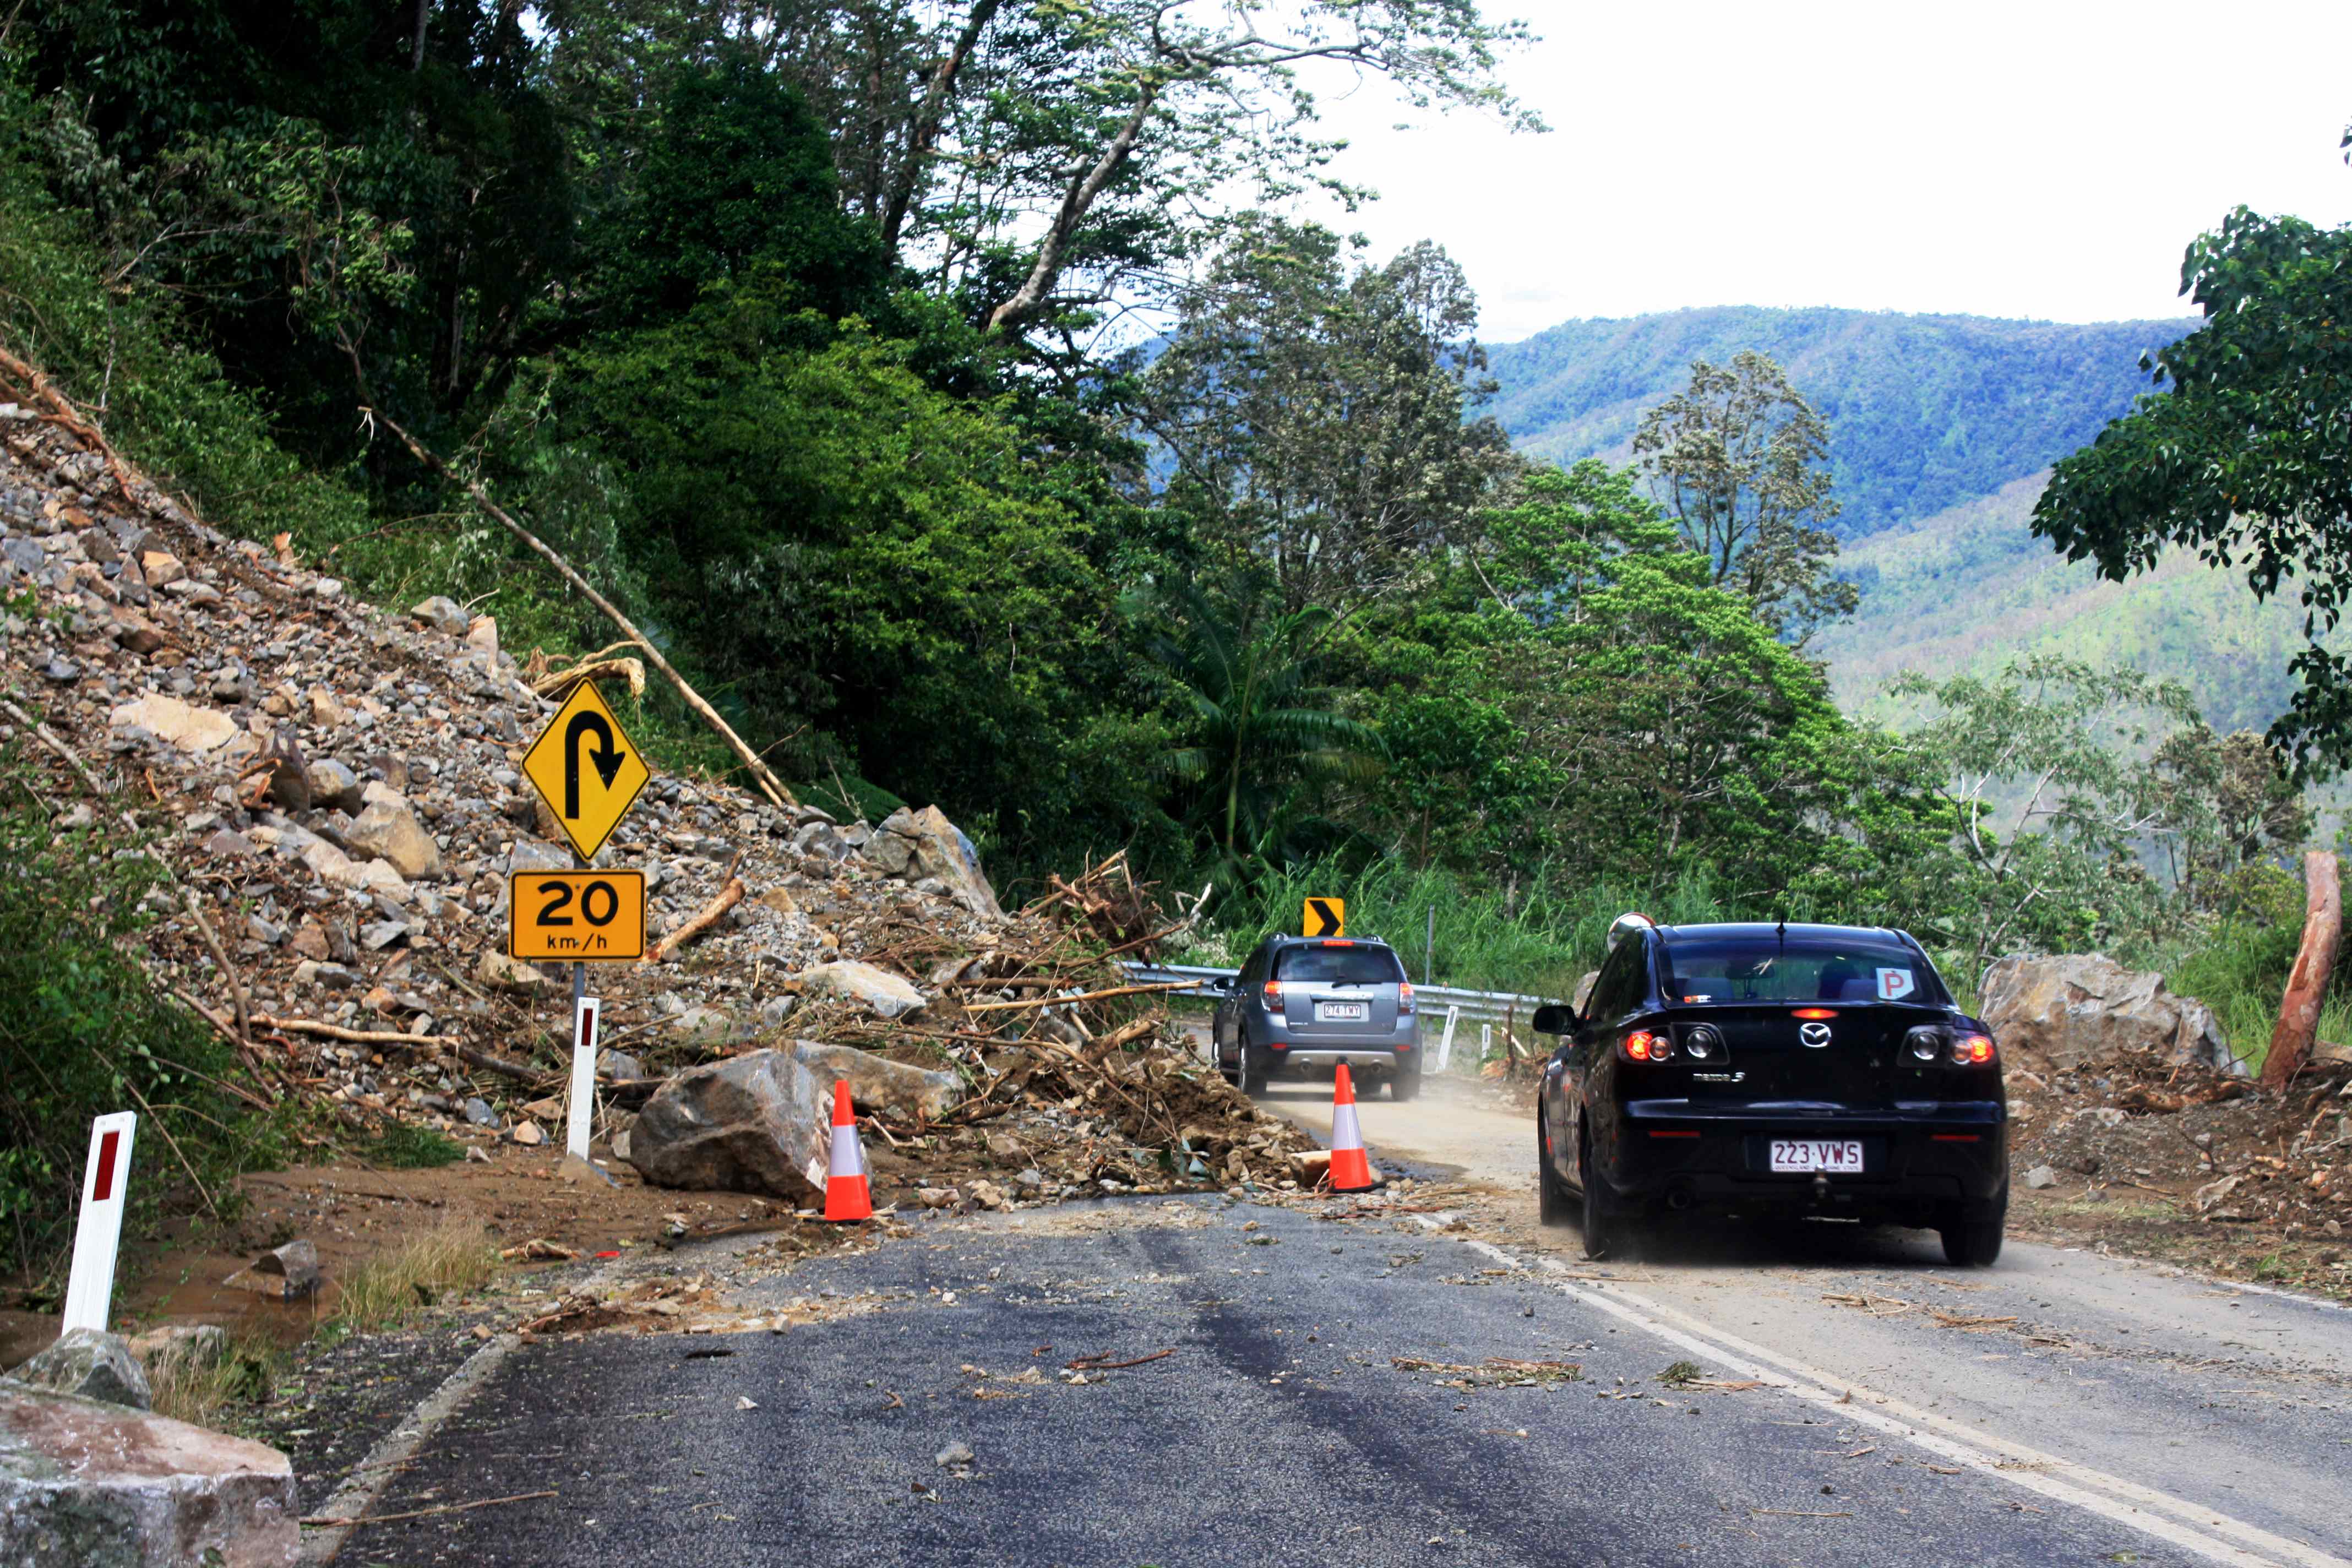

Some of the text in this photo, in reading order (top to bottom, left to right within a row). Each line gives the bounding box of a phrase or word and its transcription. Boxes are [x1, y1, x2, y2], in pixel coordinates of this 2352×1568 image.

[537, 880, 619, 926] 20
[547, 933, 607, 951] km/h
[1885, 973, 1903, 996] P
